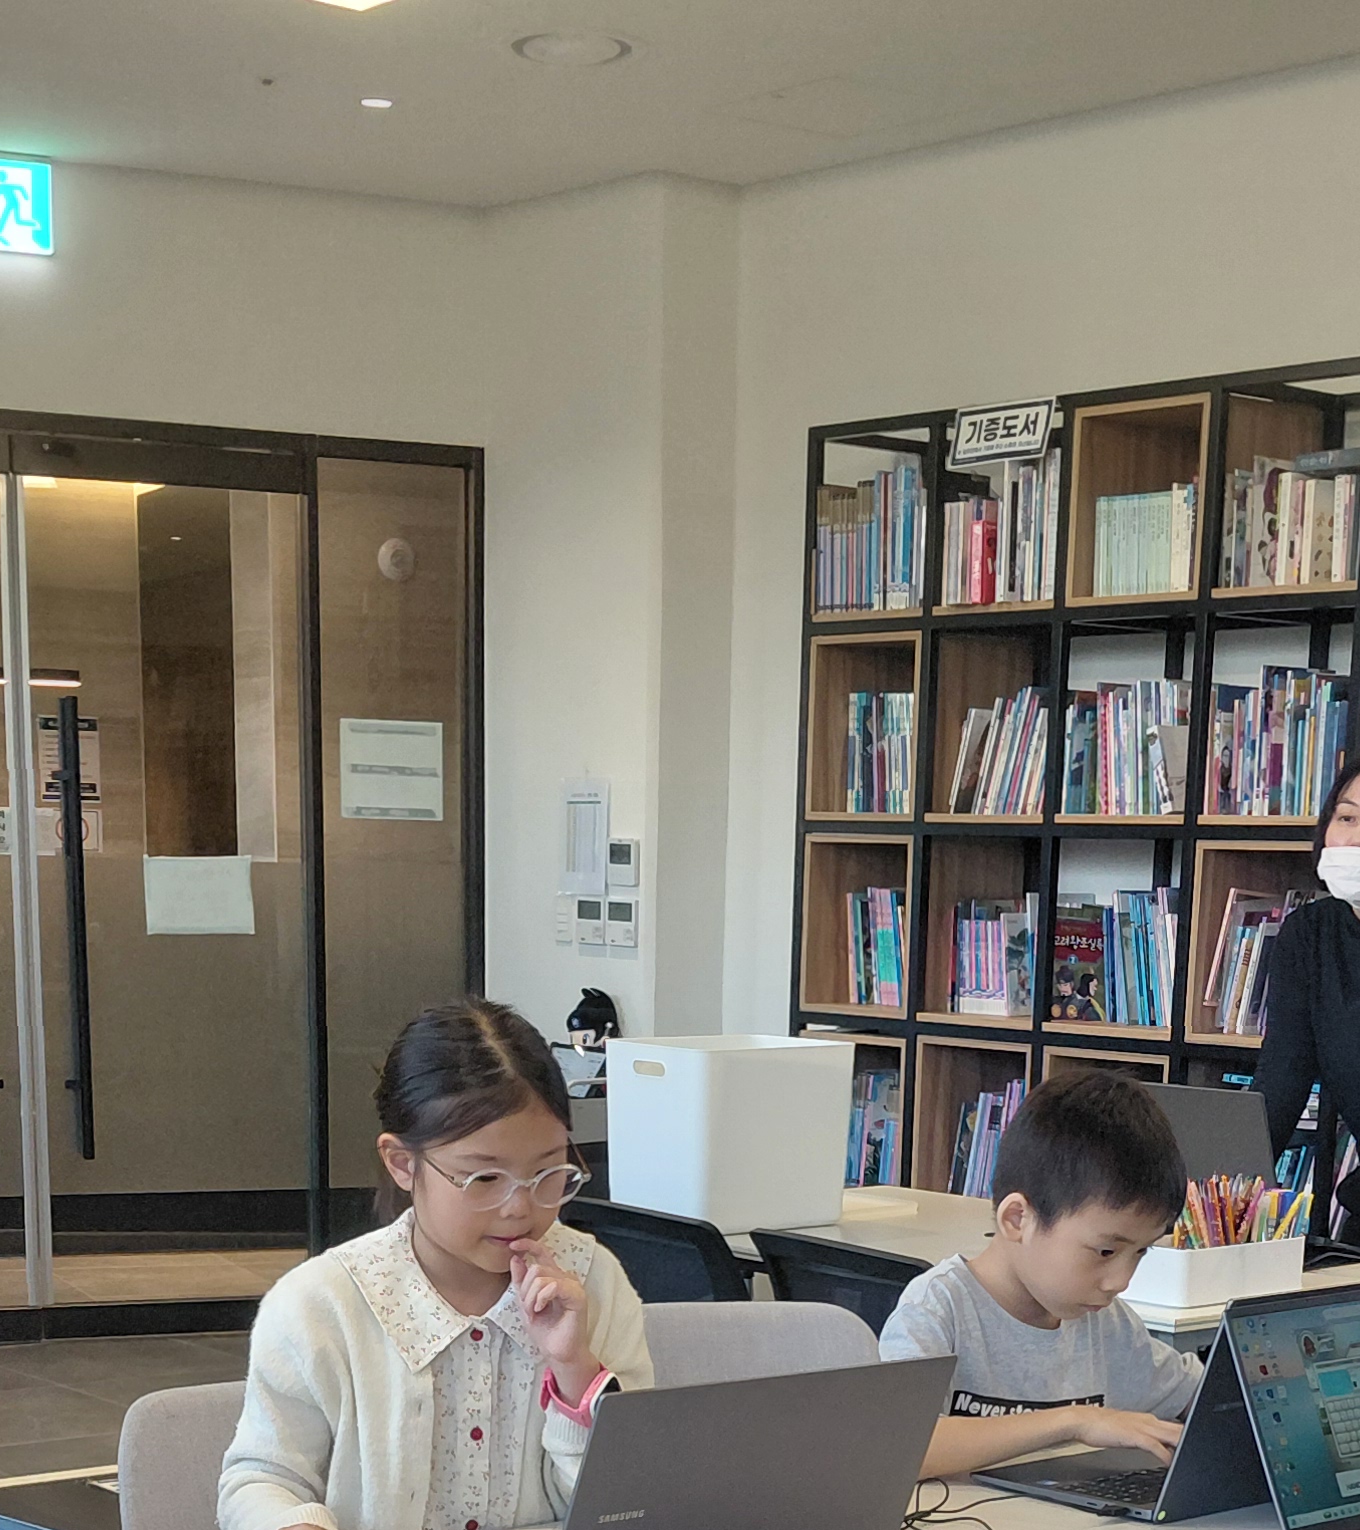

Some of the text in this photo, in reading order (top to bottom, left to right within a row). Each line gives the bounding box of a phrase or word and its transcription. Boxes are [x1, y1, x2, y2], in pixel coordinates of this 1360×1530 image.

[965, 411, 1040, 445] 기증도서
[954, 1393, 1007, 1417] Never
[597, 1509, 645, 1524] SAMSUNG
